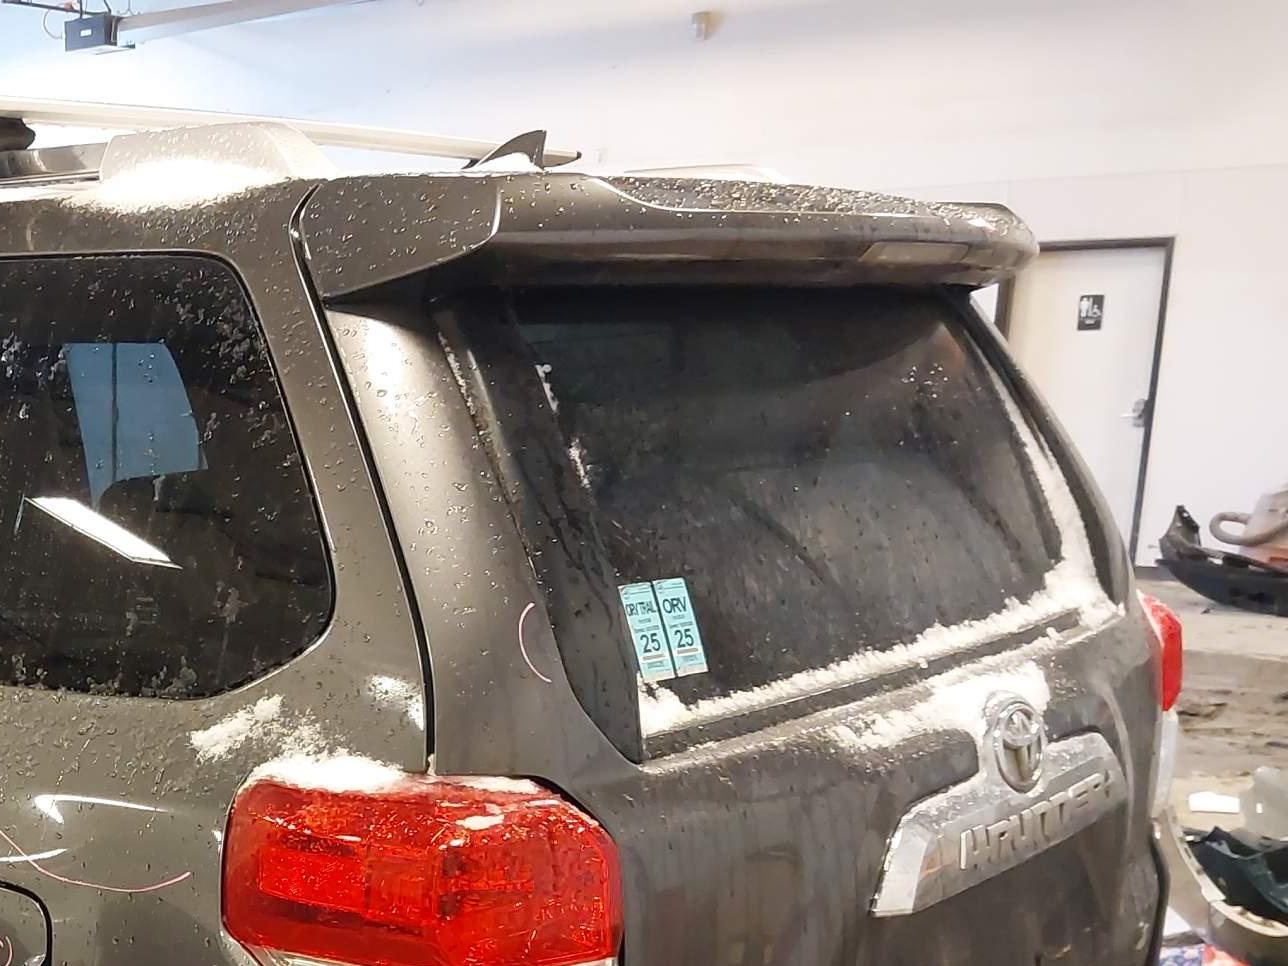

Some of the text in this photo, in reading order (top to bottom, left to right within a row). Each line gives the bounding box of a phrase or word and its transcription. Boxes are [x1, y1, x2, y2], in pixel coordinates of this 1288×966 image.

[663, 596, 688, 614] ORV
[640, 633, 661, 653] 25
[674, 629, 694, 648] 25
